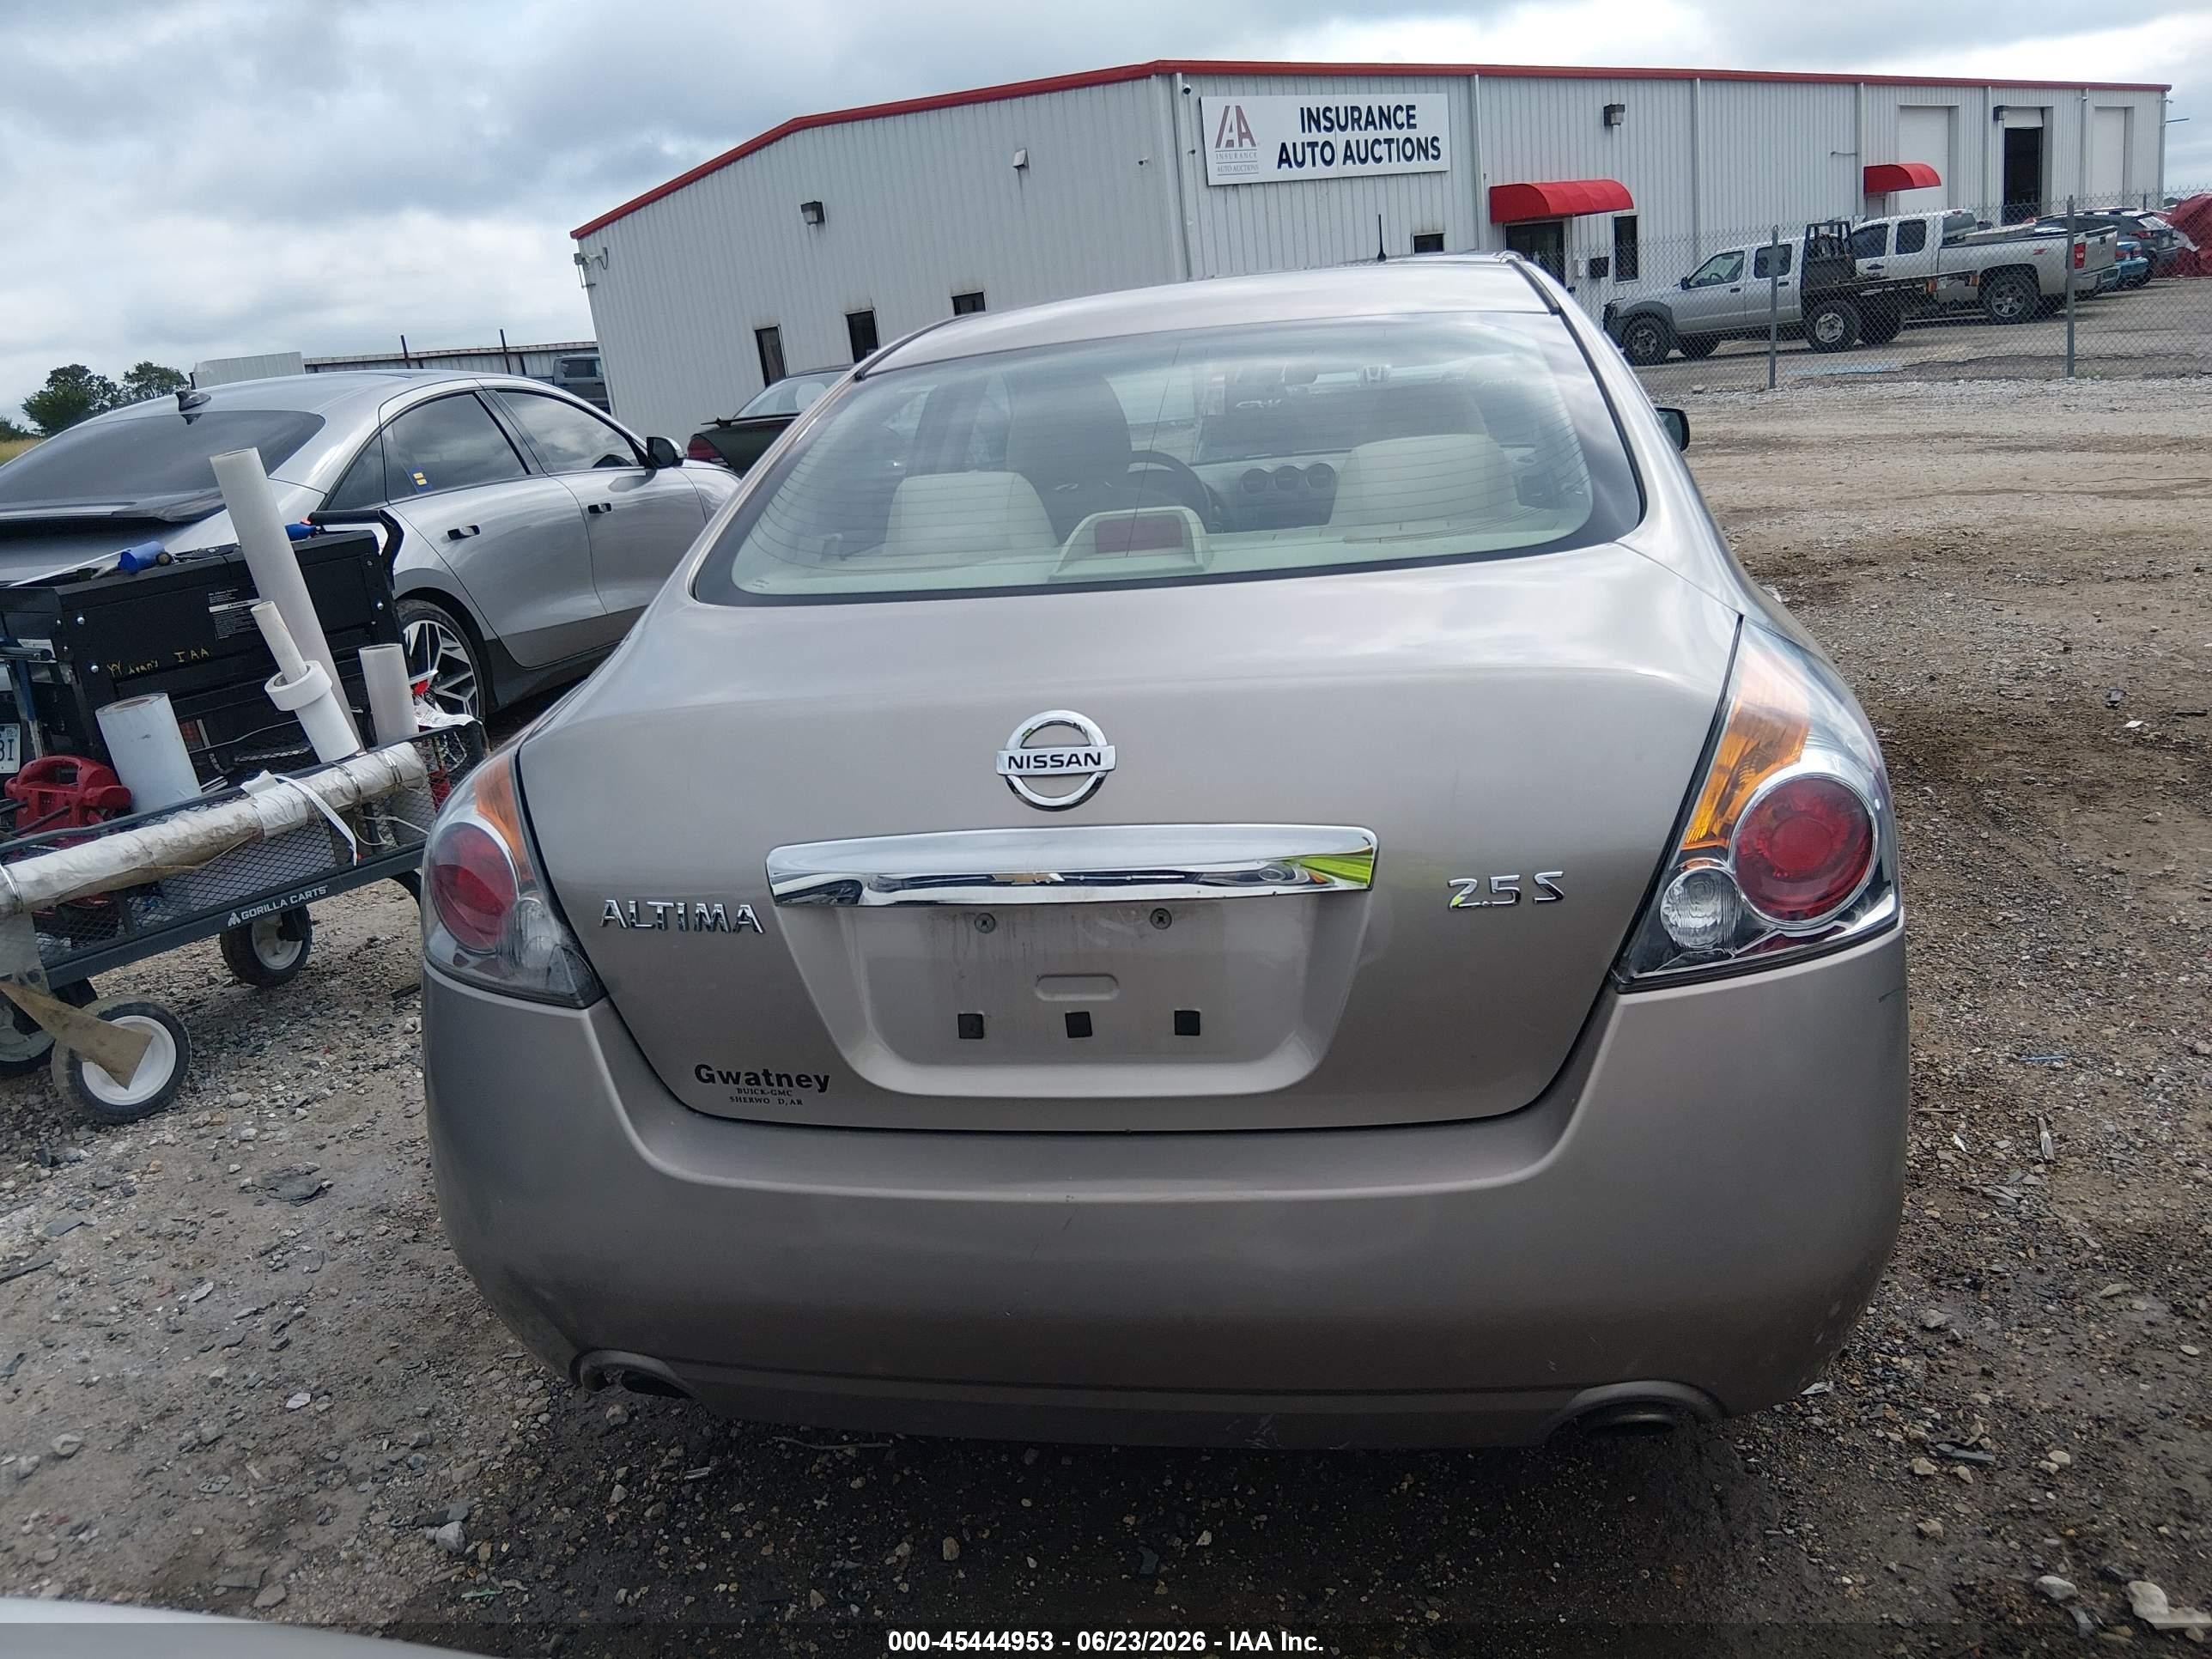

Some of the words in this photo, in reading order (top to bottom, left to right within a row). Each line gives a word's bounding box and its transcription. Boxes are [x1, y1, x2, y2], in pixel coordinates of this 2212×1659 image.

[1299, 104, 1418, 134] INSURANCE
[1216, 151, 1257, 161] INSURANCE
[1277, 140, 1335, 169] AUTO
[1342, 136, 1441, 166] AUCTIONS
[1008, 751, 1102, 769] NISSAN
[240, 898, 289, 921] GORILLA
[289, 886, 327, 904] CARTS
[1449, 874, 1521, 909] 2.5
[1534, 871, 1565, 903] S
[600, 899, 764, 934] ALTIMA
[695, 1064, 830, 1093] Gwatney
[737, 1087, 793, 1097] BUICK-GMC
